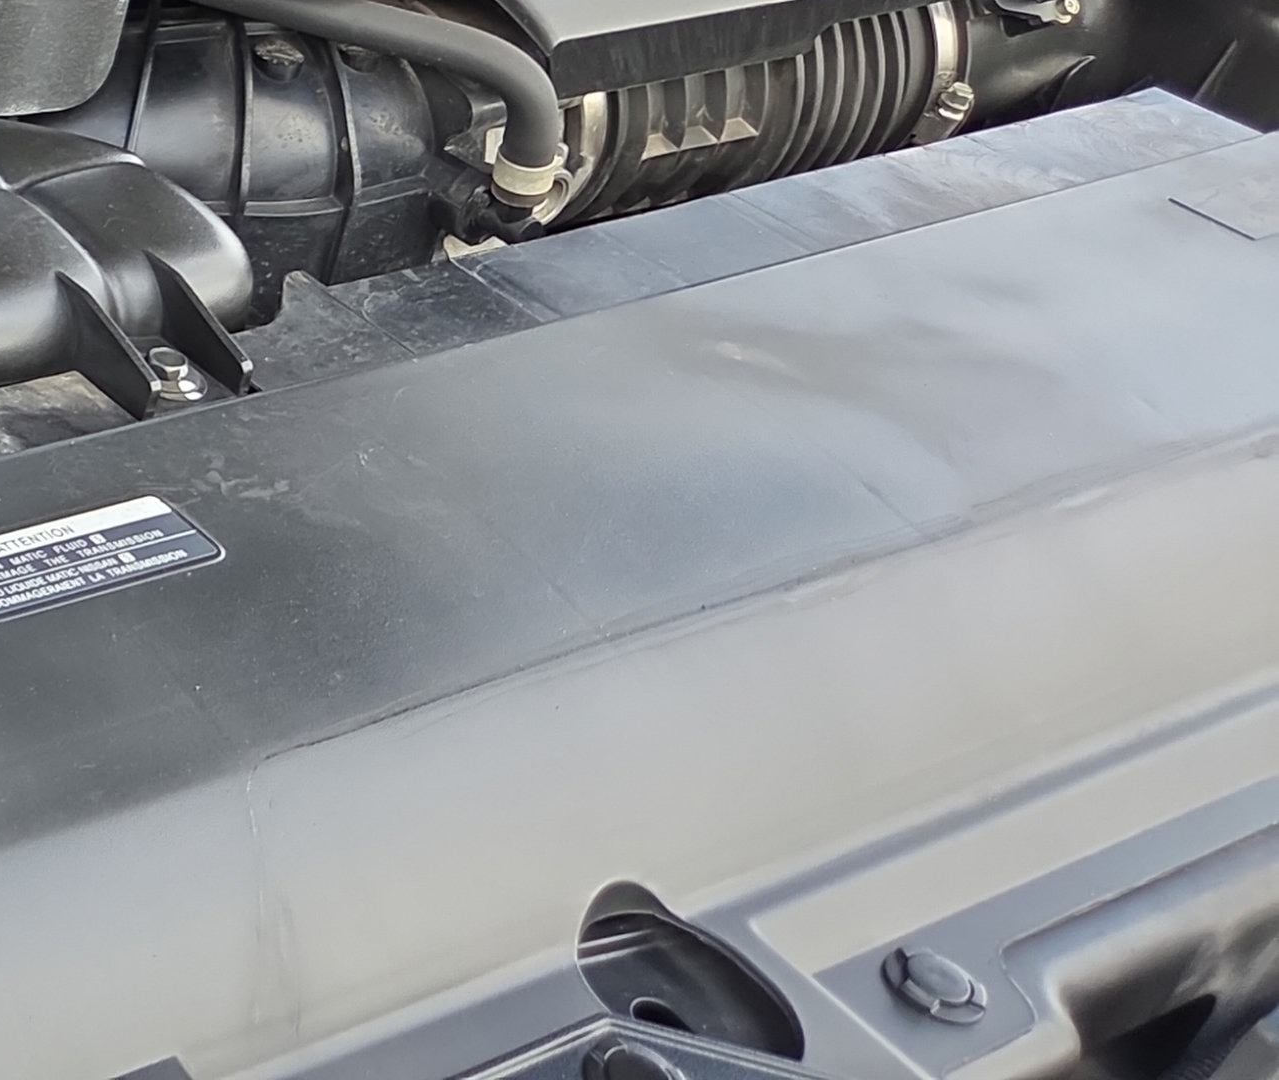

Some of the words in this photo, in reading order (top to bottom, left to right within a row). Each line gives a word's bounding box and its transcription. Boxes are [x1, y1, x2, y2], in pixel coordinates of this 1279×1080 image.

[8, 547, 48, 567] MATIC
[53, 536, 88, 554] FLUID
[42, 553, 69, 568] THE
[75, 526, 164, 560] TRANSMISSION
[88, 571, 104, 583] LA
[107, 547, 188, 579] TRANSMISSION
[4, 575, 47, 595] LIQUIDE
[45, 566, 78, 583] MATIC
[78, 555, 119, 575] NISSAN
